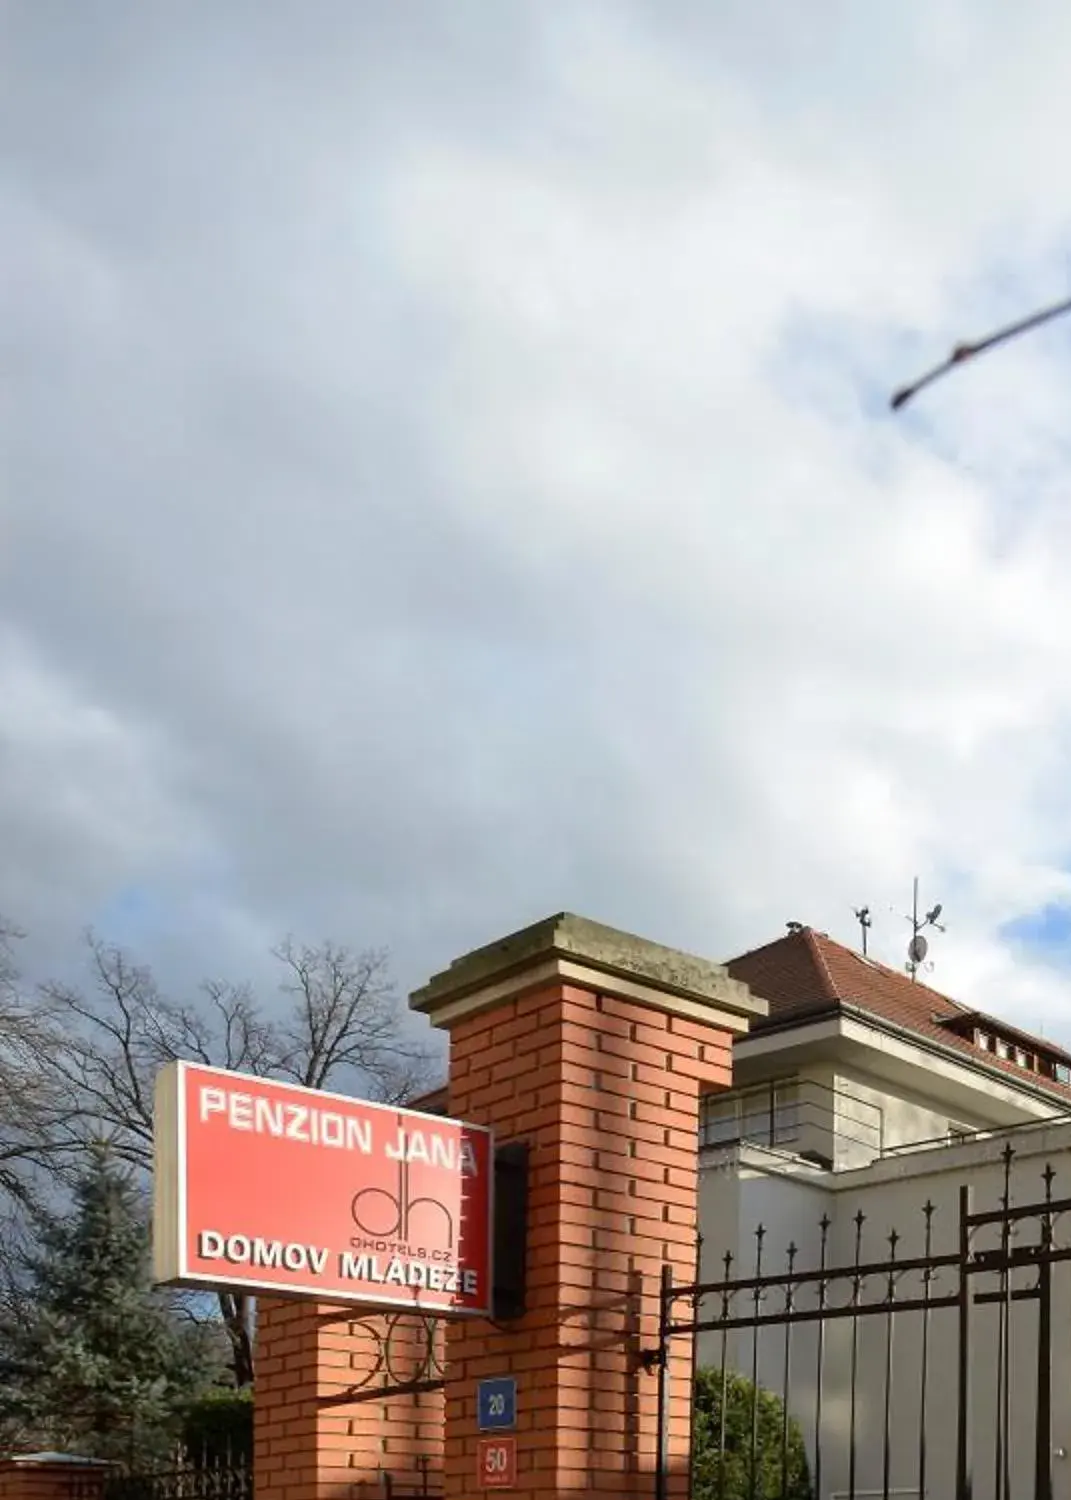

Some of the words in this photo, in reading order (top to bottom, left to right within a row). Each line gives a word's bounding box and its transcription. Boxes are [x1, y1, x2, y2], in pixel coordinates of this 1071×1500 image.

[199, 1086, 372, 1154] PENZION
[384, 1127, 479, 1176] JANA
[198, 1230, 328, 1275] DOMOV
[488, 1393, 505, 1416] 20
[485, 1447, 508, 1473] 50
